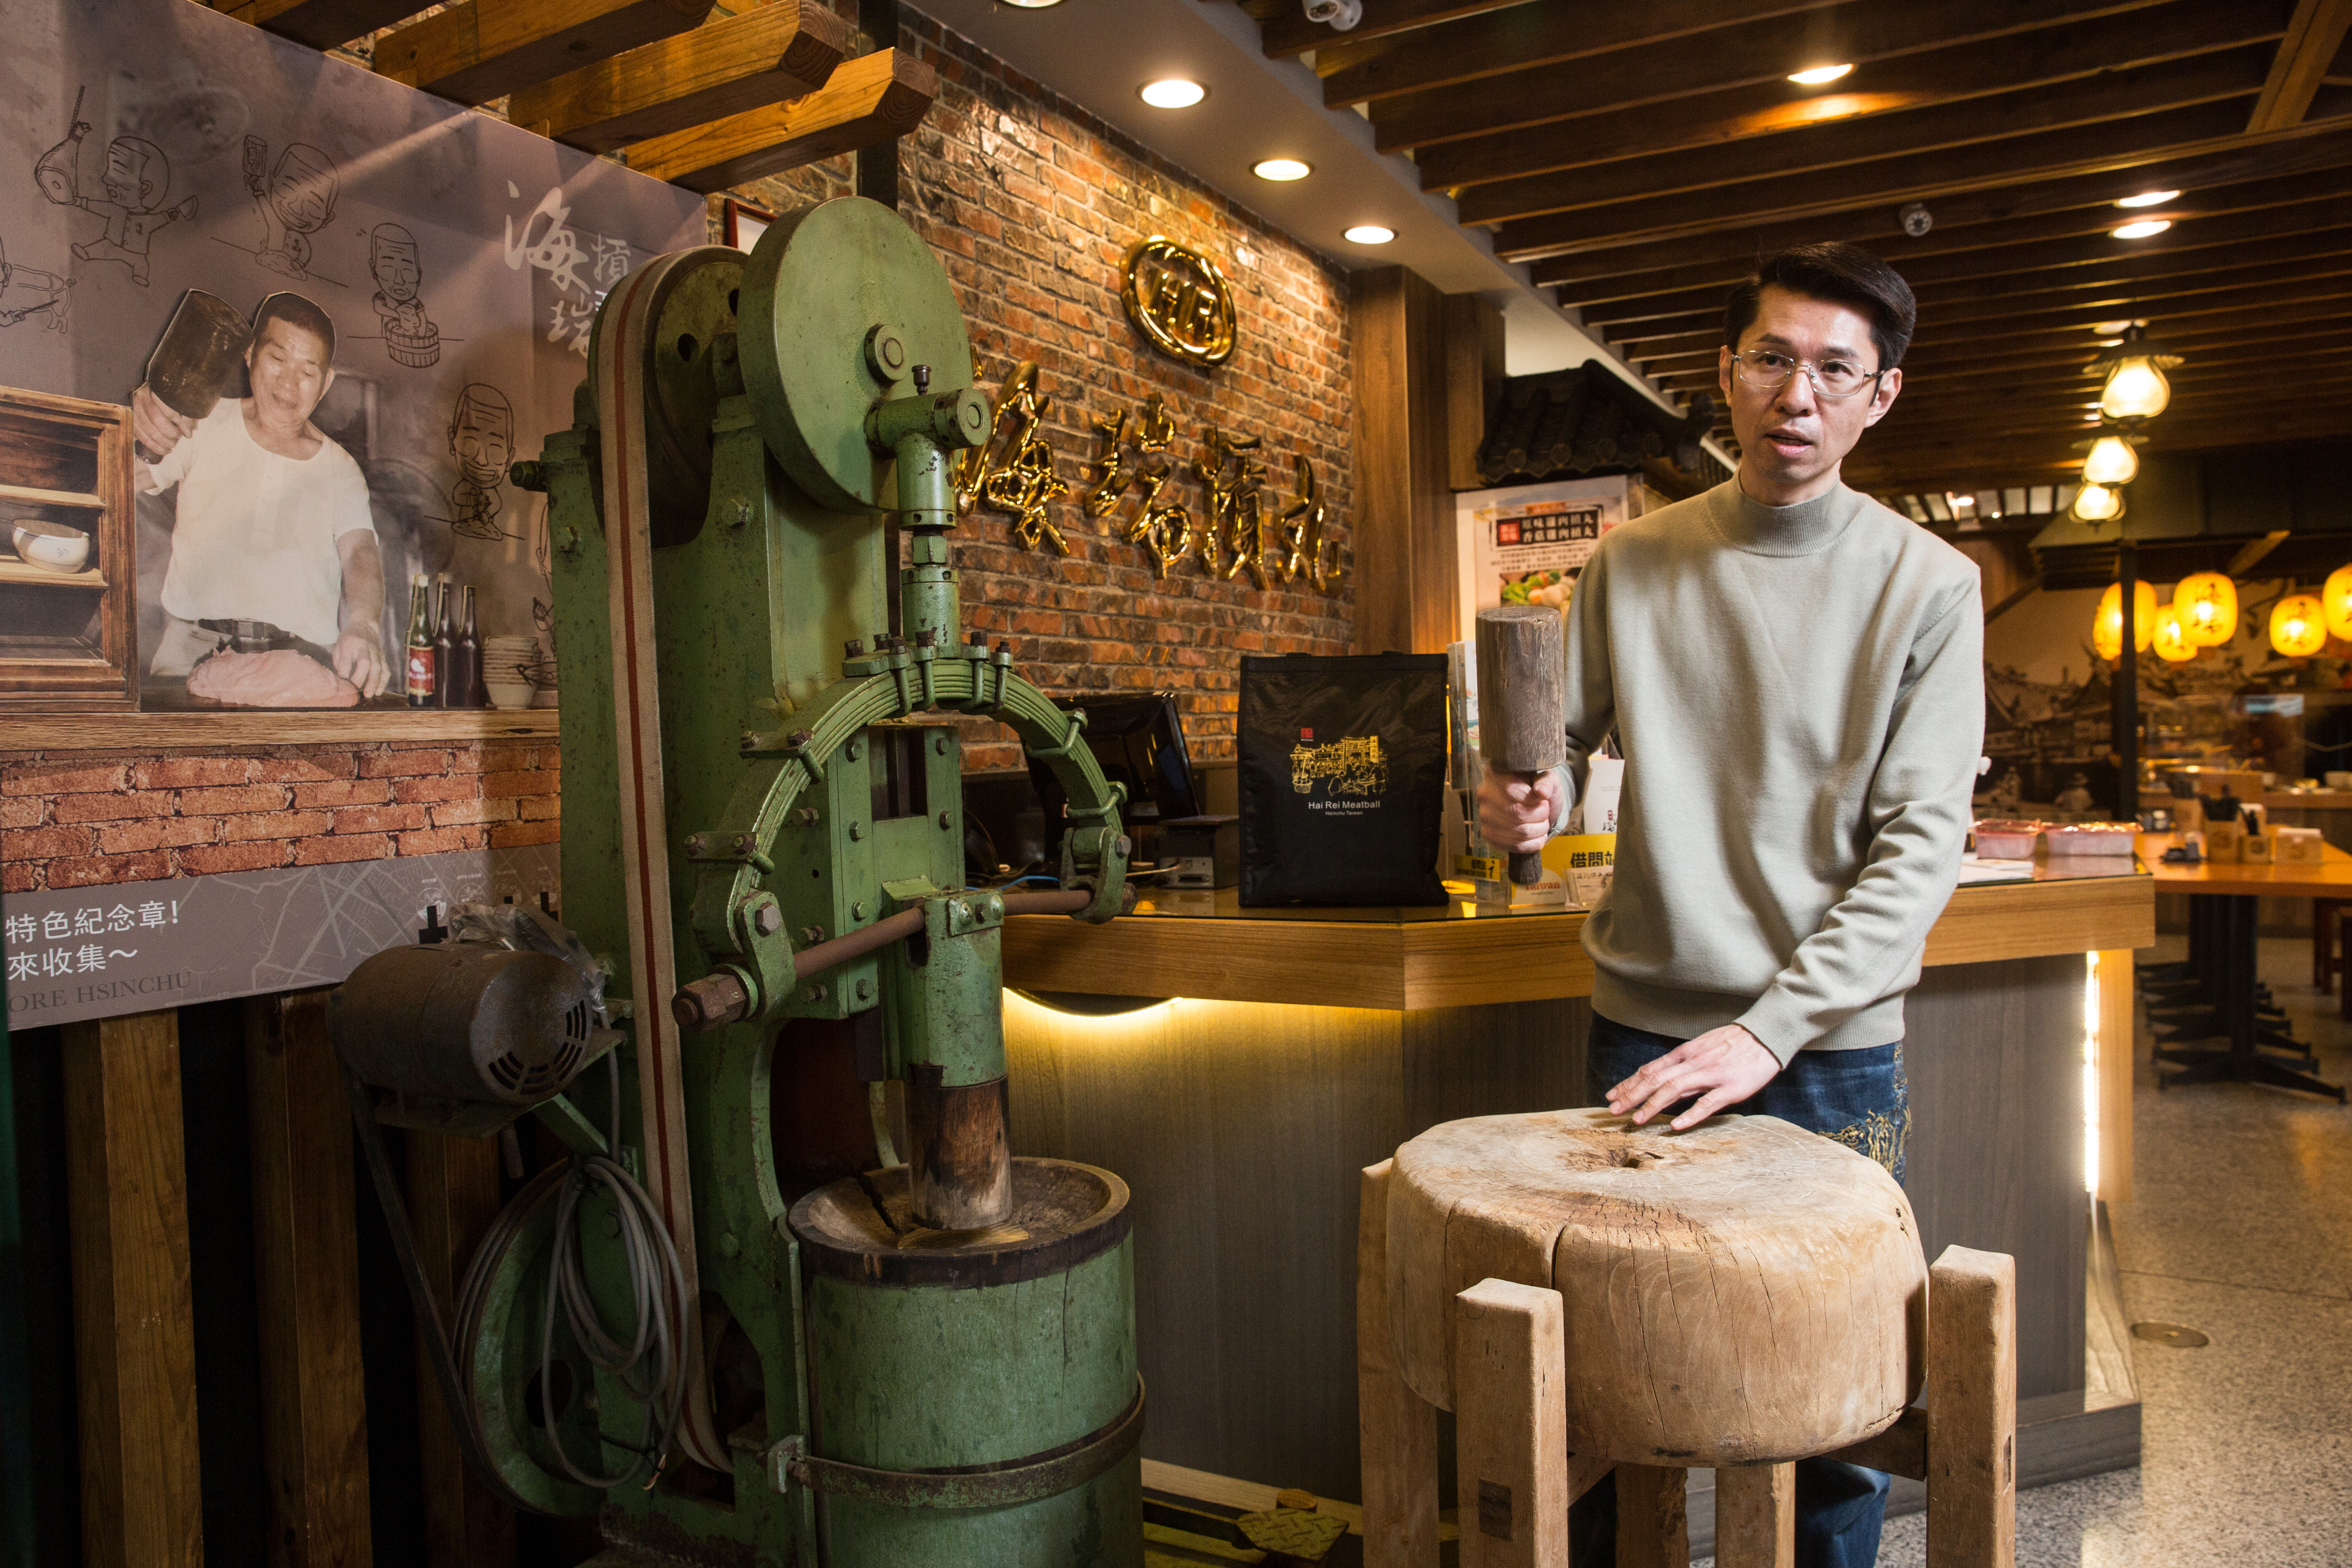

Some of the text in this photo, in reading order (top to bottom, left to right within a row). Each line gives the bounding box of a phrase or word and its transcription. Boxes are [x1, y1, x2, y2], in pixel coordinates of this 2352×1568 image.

[1308, 801, 1323, 809] Hai
[1342, 800, 1381, 809] Meatball
[76, 971, 193, 1003] HSINCHU
